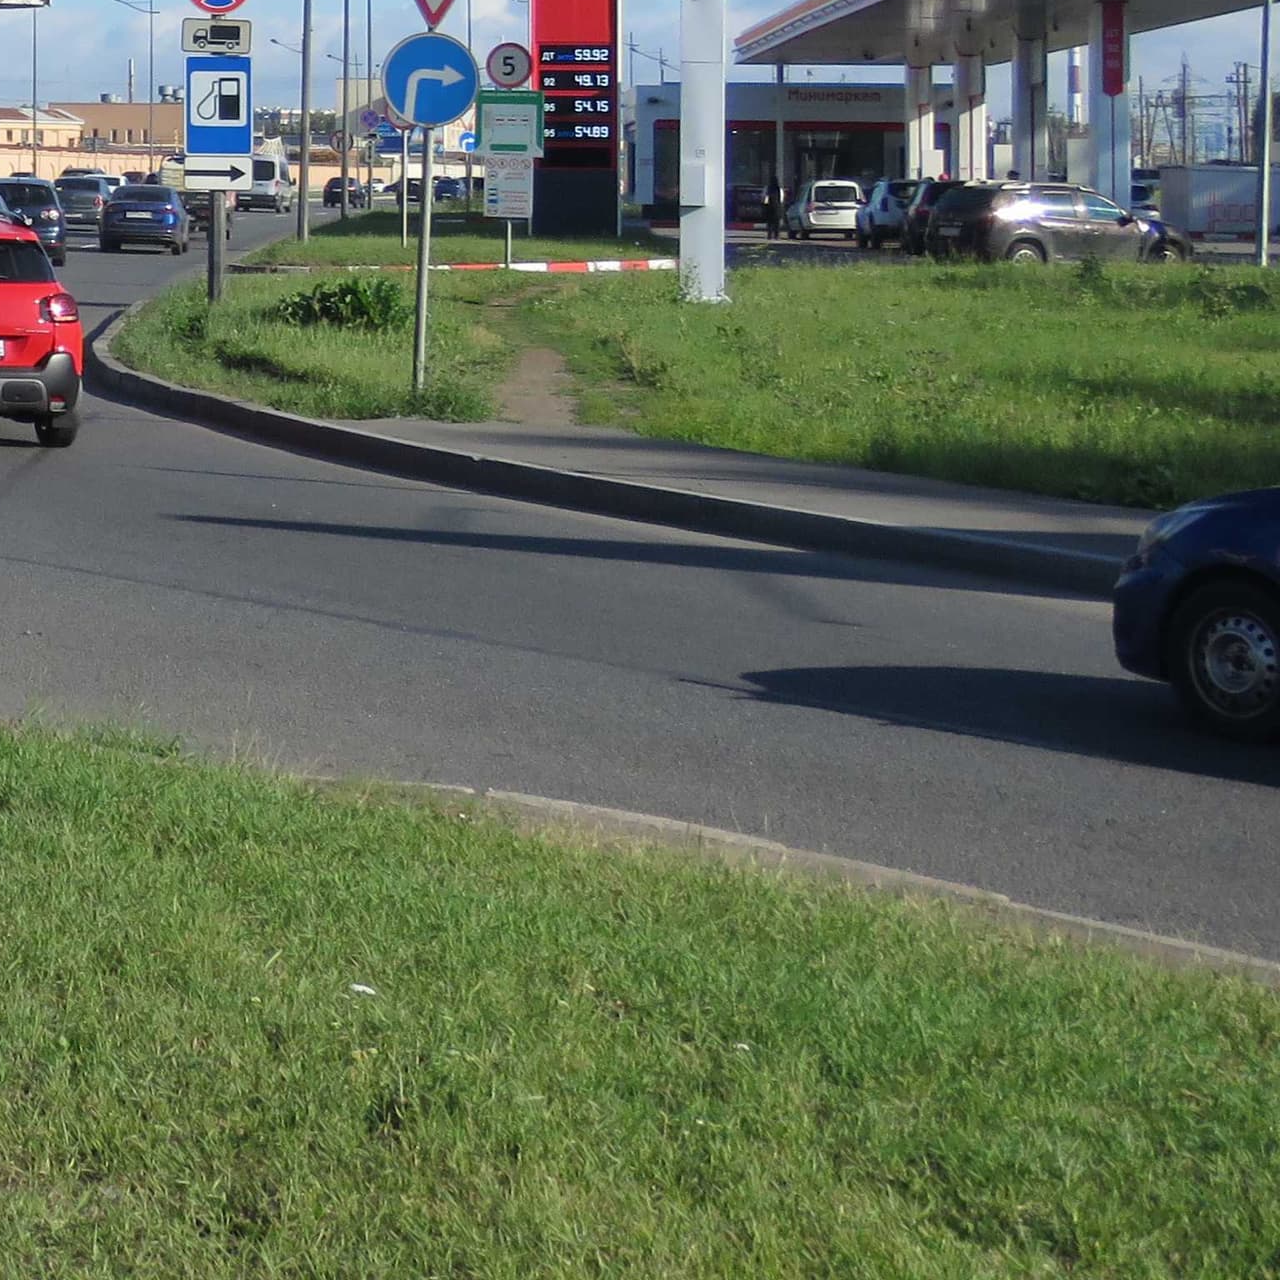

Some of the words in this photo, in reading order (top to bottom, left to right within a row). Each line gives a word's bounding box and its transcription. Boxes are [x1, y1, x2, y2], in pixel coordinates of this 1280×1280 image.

[541, 52, 555, 61] ДТ
[574, 49, 609, 61] 59.92
[502, 56, 515, 76] 5
[543, 77, 556, 86] 92
[574, 74, 609, 87] 49.13
[544, 103, 556, 112] 95
[574, 100, 609, 112] 54.15
[574, 126, 609, 138] 54.89
